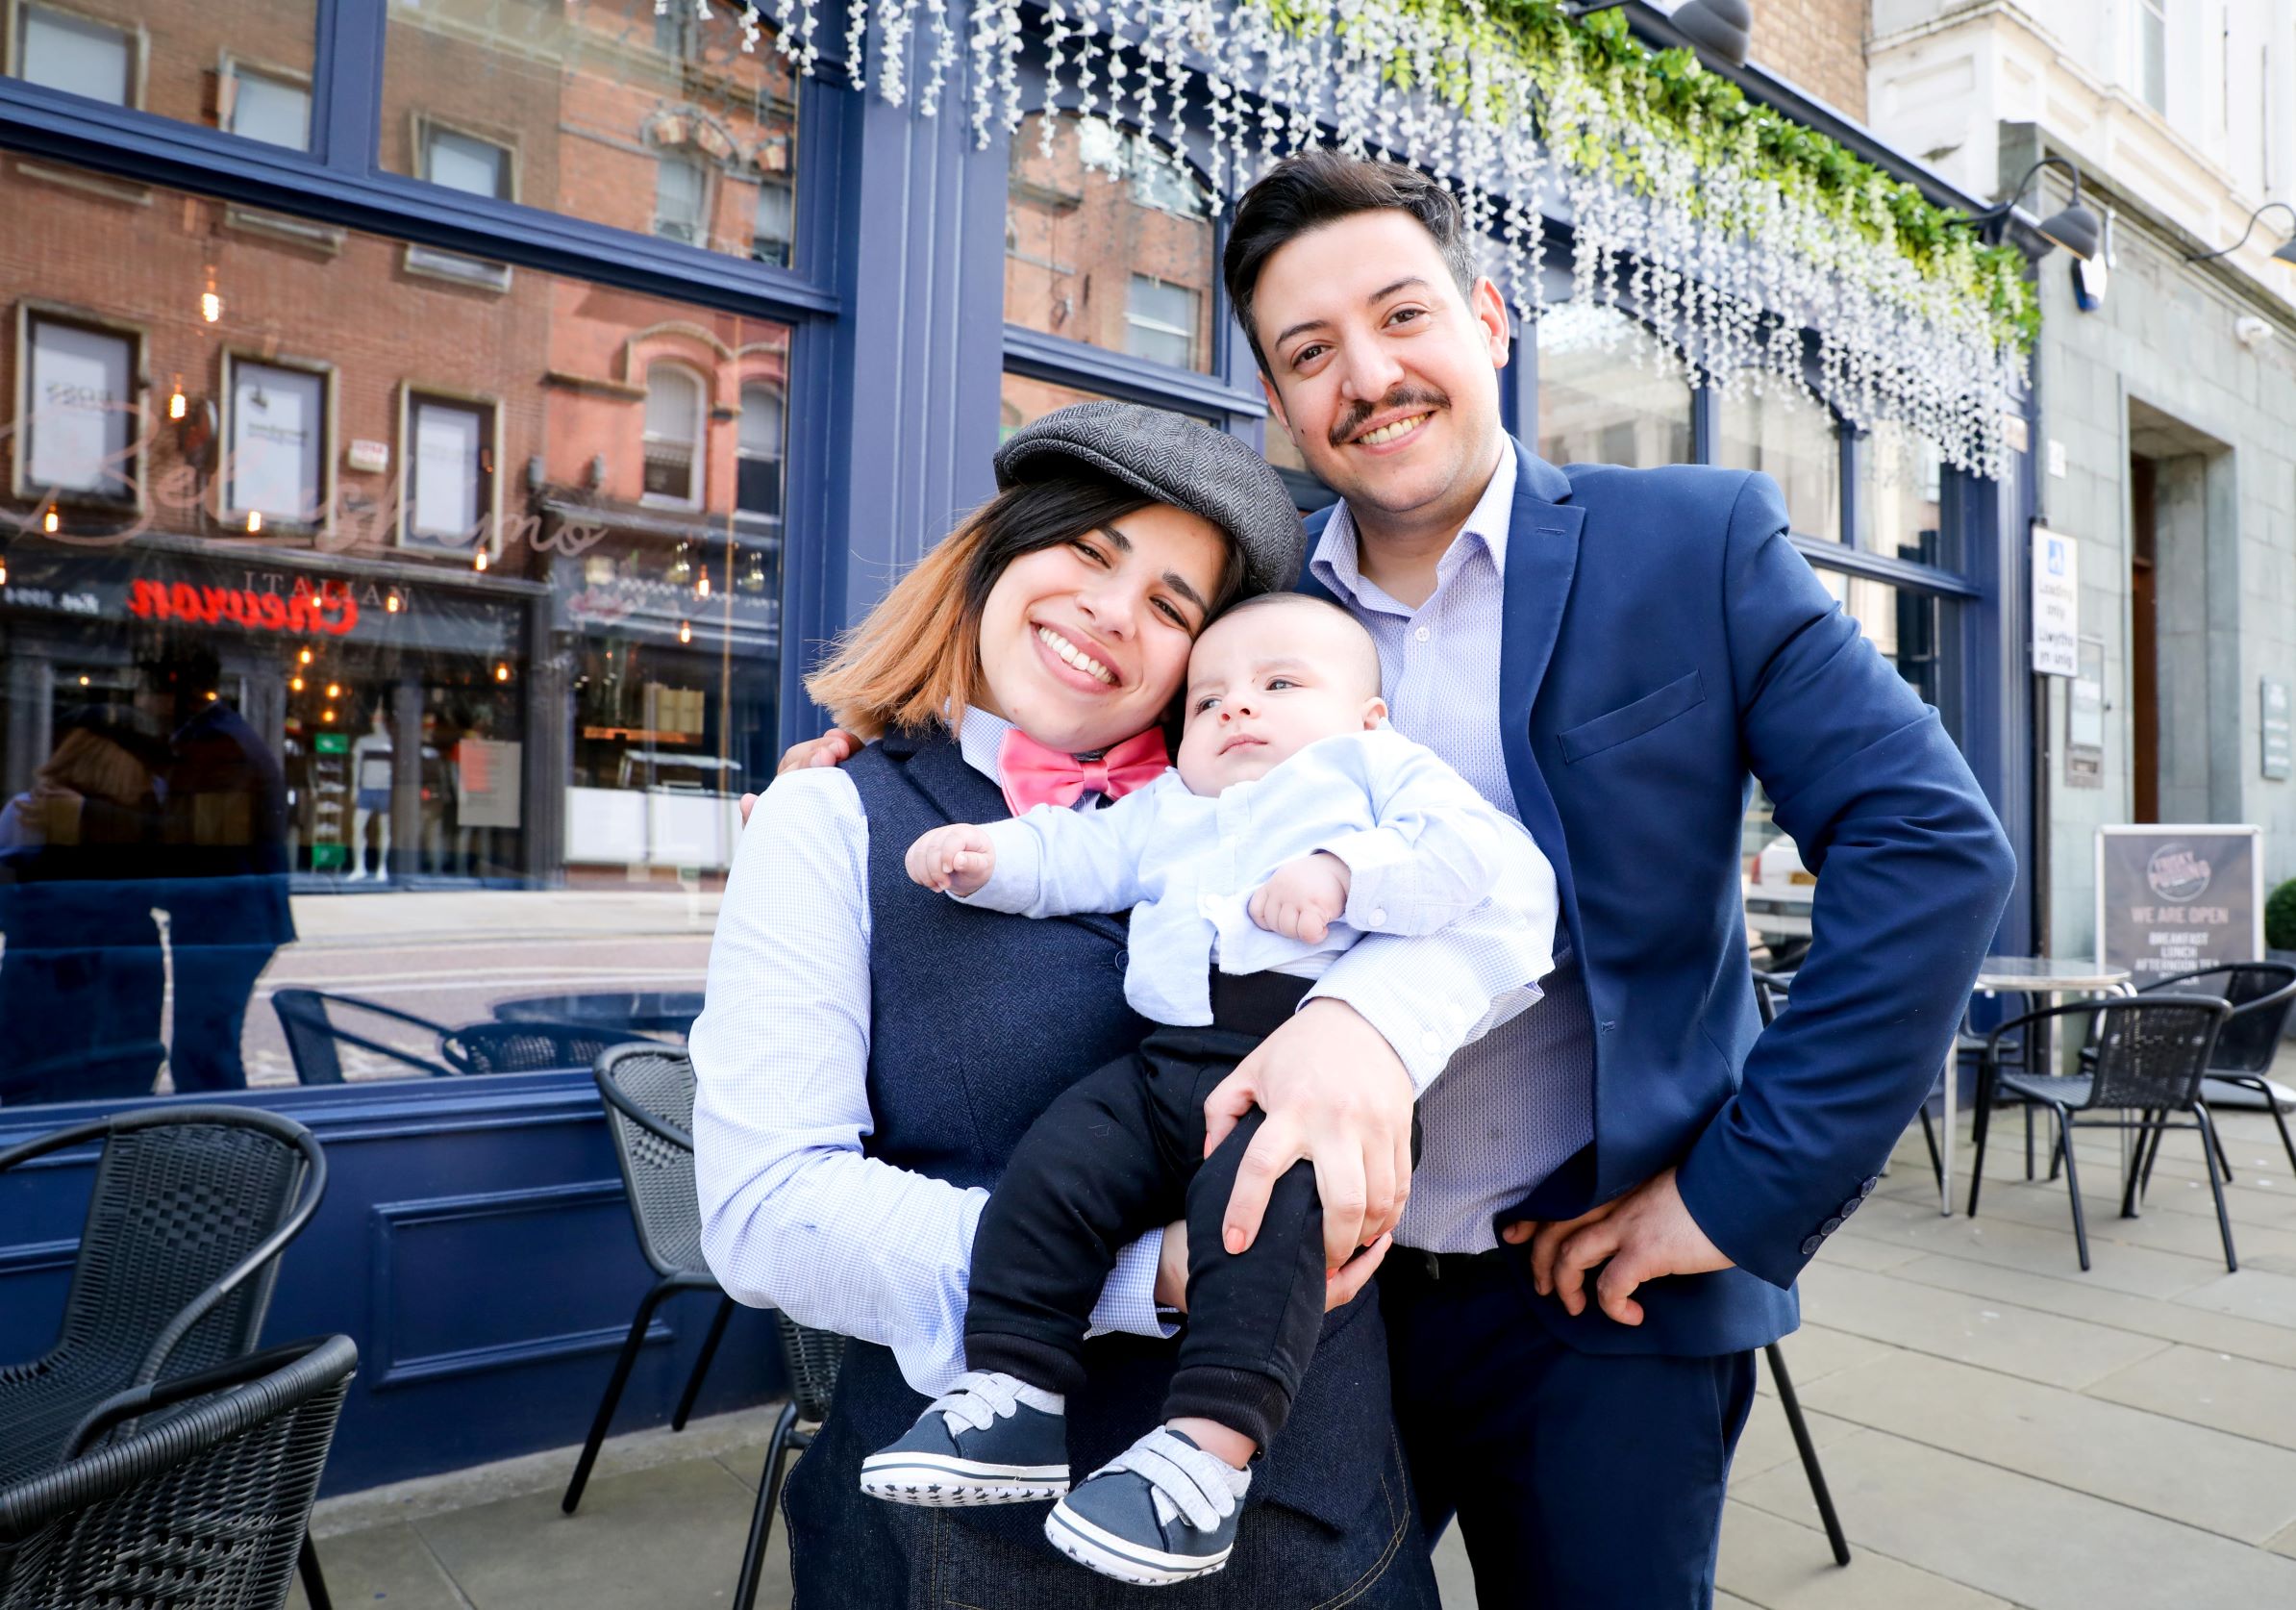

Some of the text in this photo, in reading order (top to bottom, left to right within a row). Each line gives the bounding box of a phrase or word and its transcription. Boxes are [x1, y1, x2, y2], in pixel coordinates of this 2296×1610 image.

[243, 570, 412, 614] ITALIAN
[2131, 907, 2229, 924] WE ARE OPEN
[2149, 931, 2209, 946] BREAKFAST
[2160, 945, 2199, 959] LUNCH
